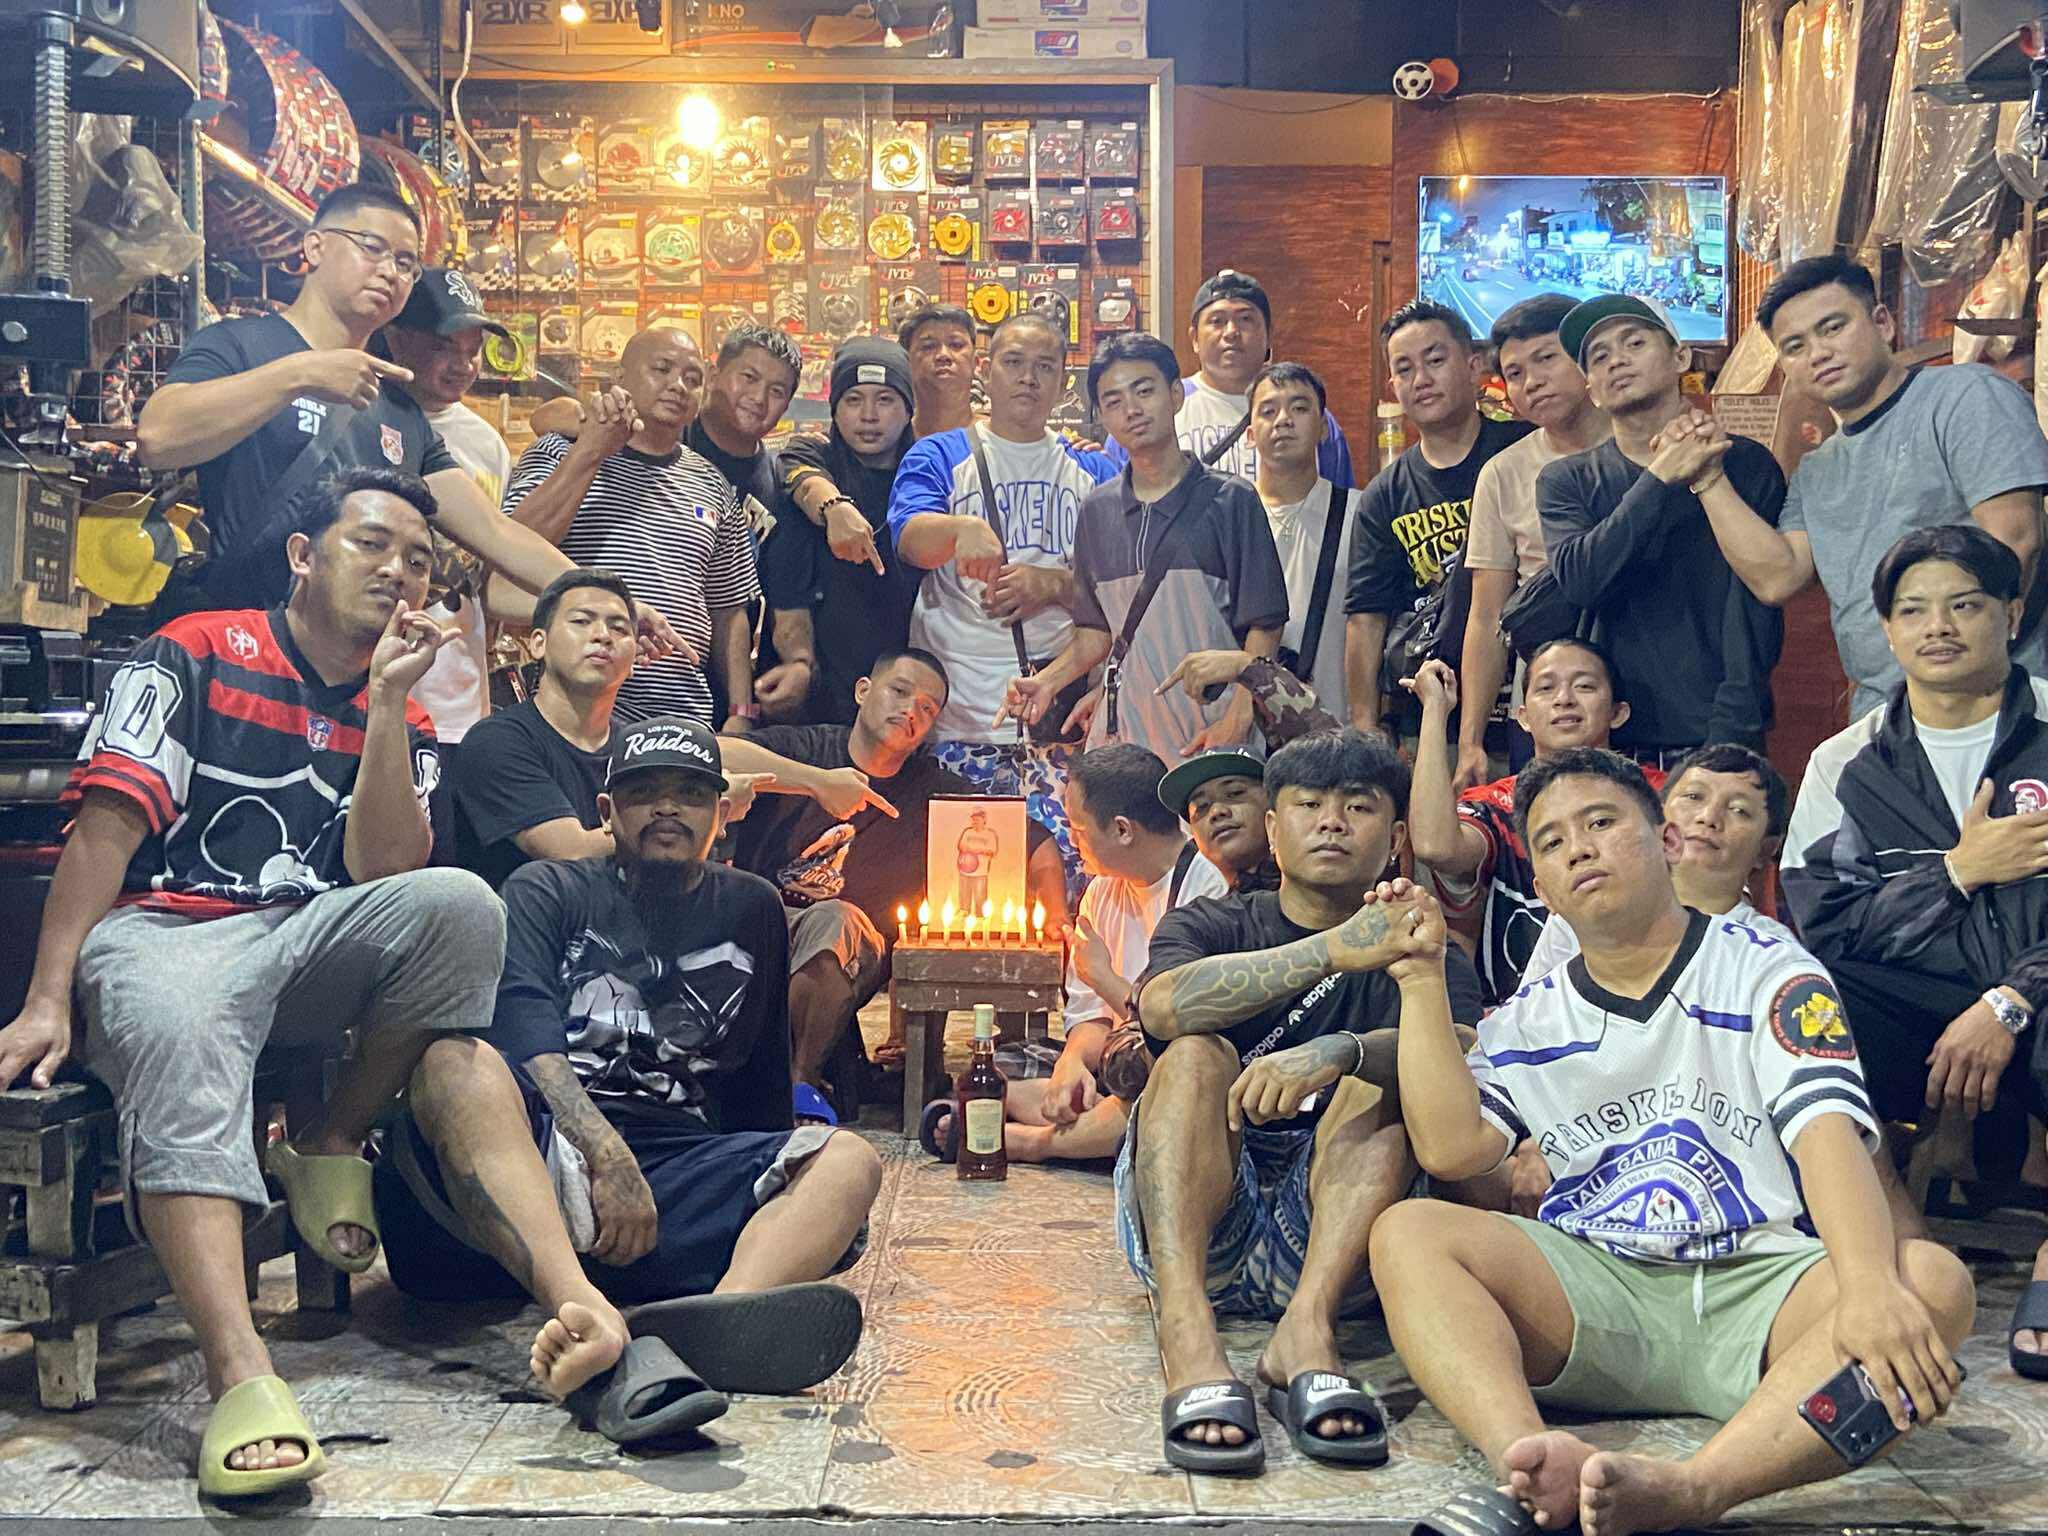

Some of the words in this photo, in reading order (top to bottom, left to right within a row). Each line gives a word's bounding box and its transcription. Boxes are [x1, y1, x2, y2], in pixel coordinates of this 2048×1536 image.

[298, 410, 320, 435] 21
[624, 732, 714, 763] Raiders
[1562, 1174, 1607, 1211] TAU
[1688, 1149, 1727, 1192] PHI
[1186, 1385, 1232, 1404] NIKE
[1313, 1374, 1350, 1390] NIKE
